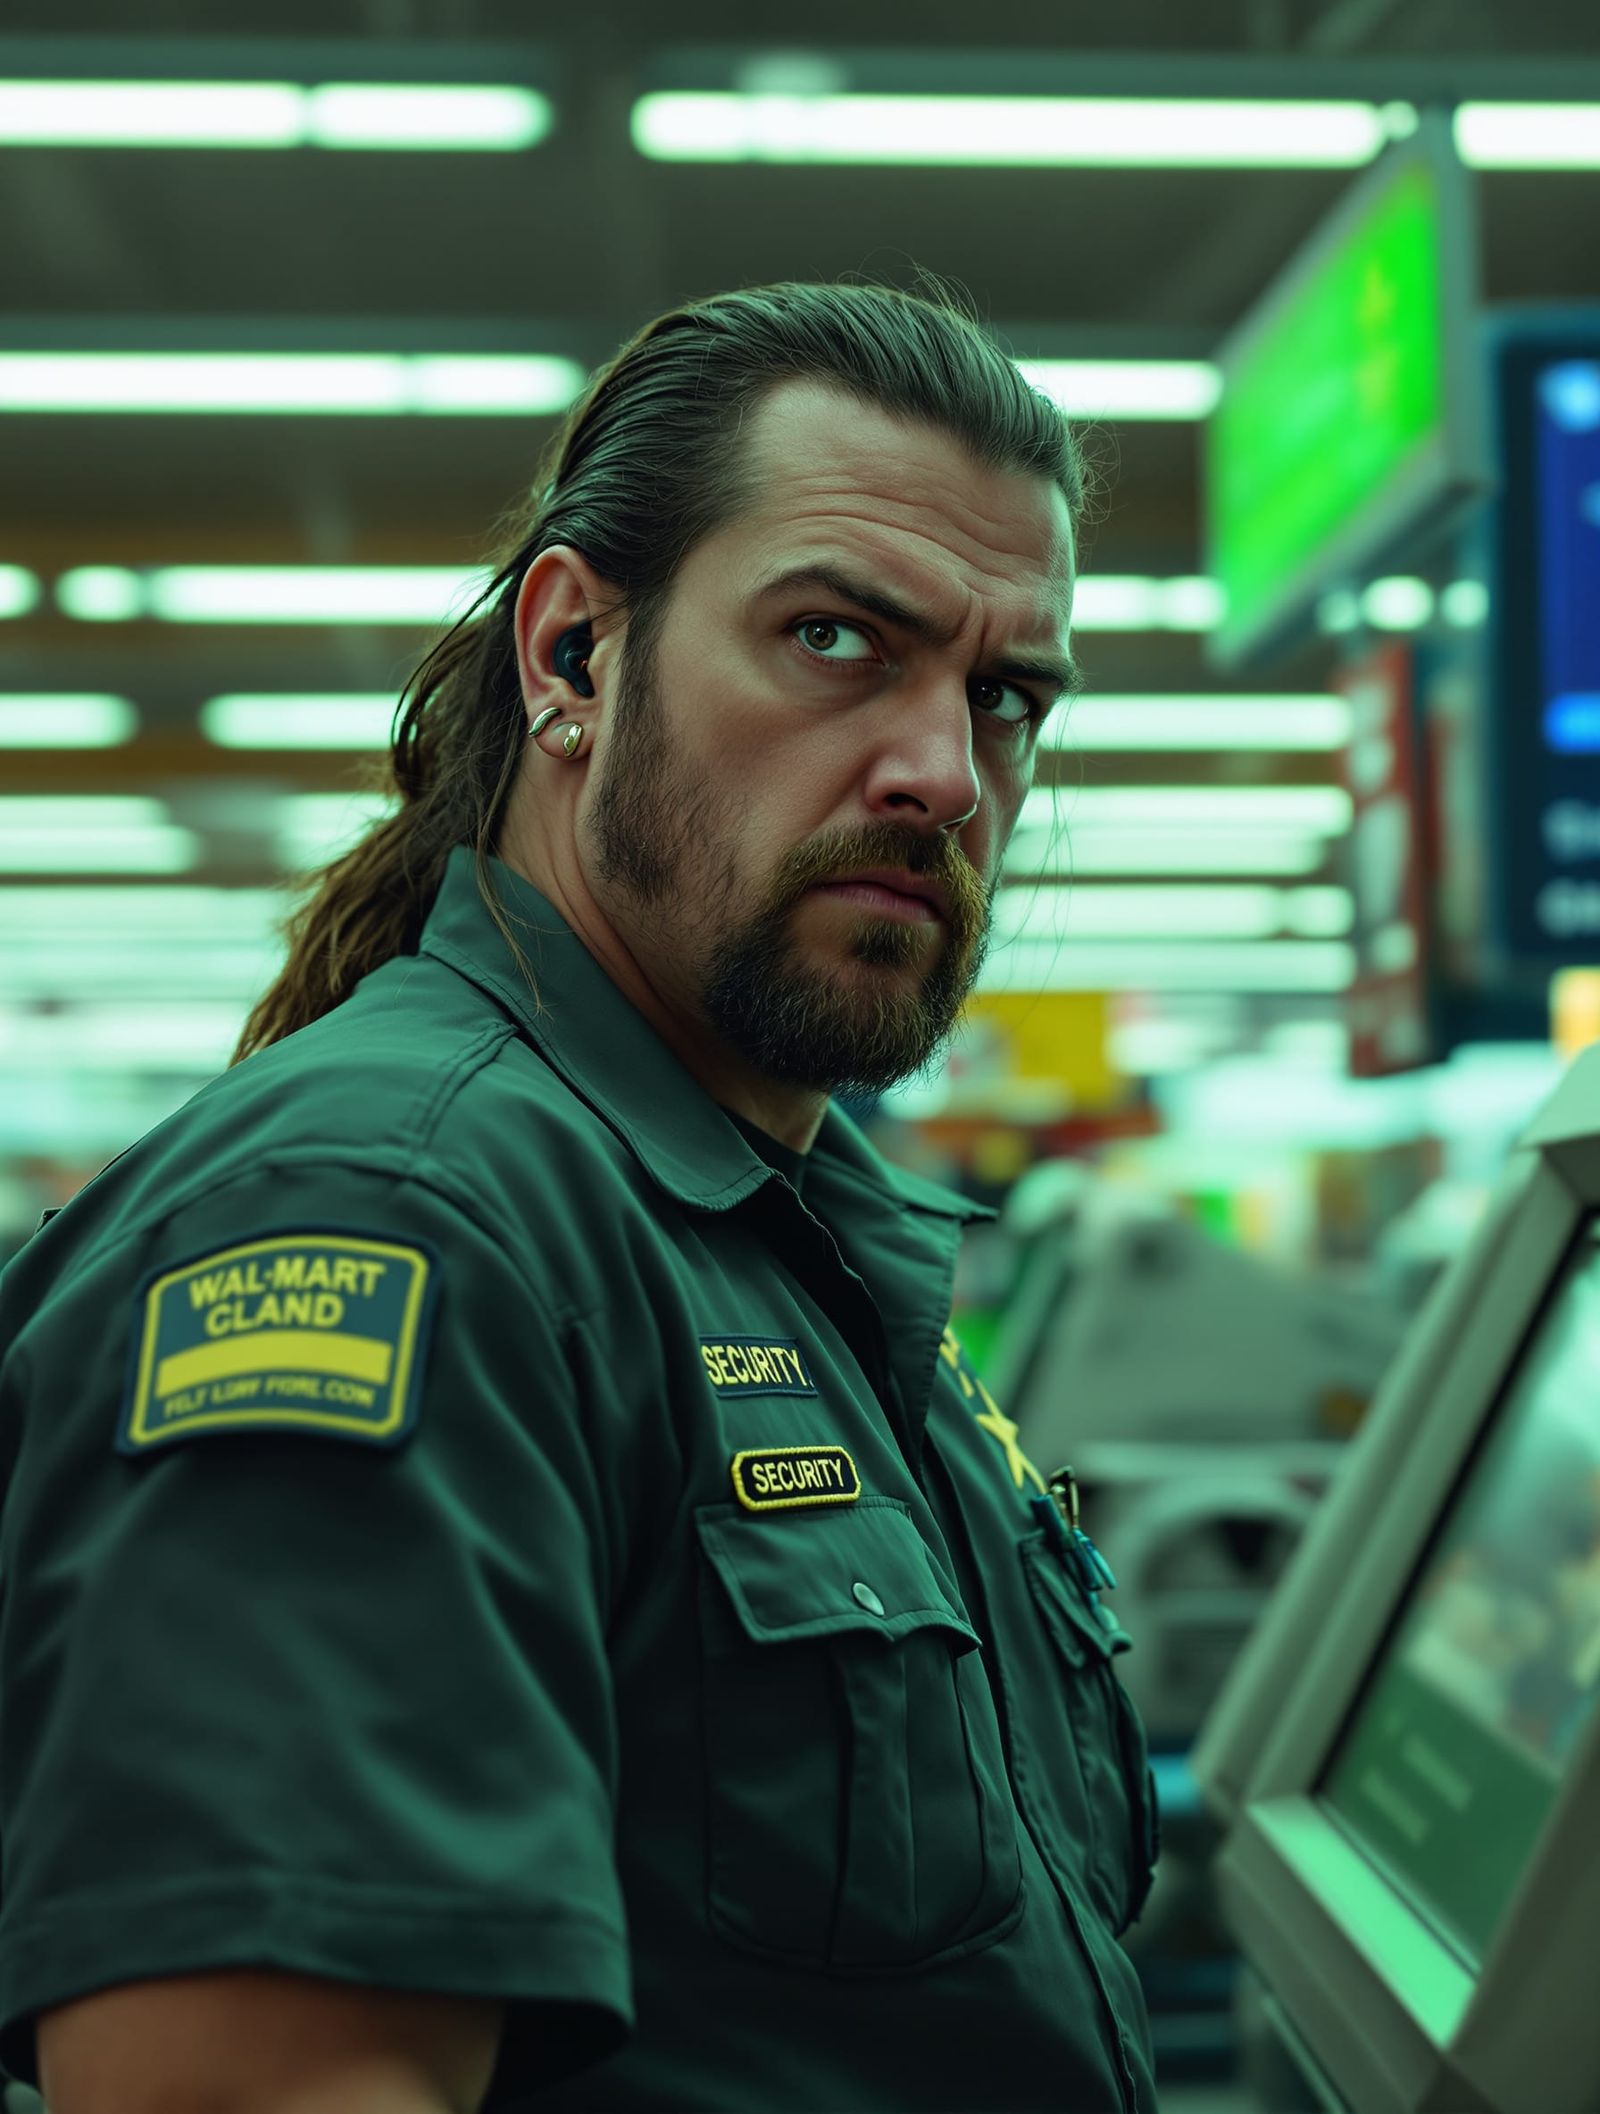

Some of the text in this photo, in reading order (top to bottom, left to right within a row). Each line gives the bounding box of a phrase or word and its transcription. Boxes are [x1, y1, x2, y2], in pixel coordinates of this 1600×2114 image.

[205, 1292, 344, 1337] CLAND
[700, 1345, 808, 1386] SECURITY
[751, 1458, 844, 1493] SECURITY
